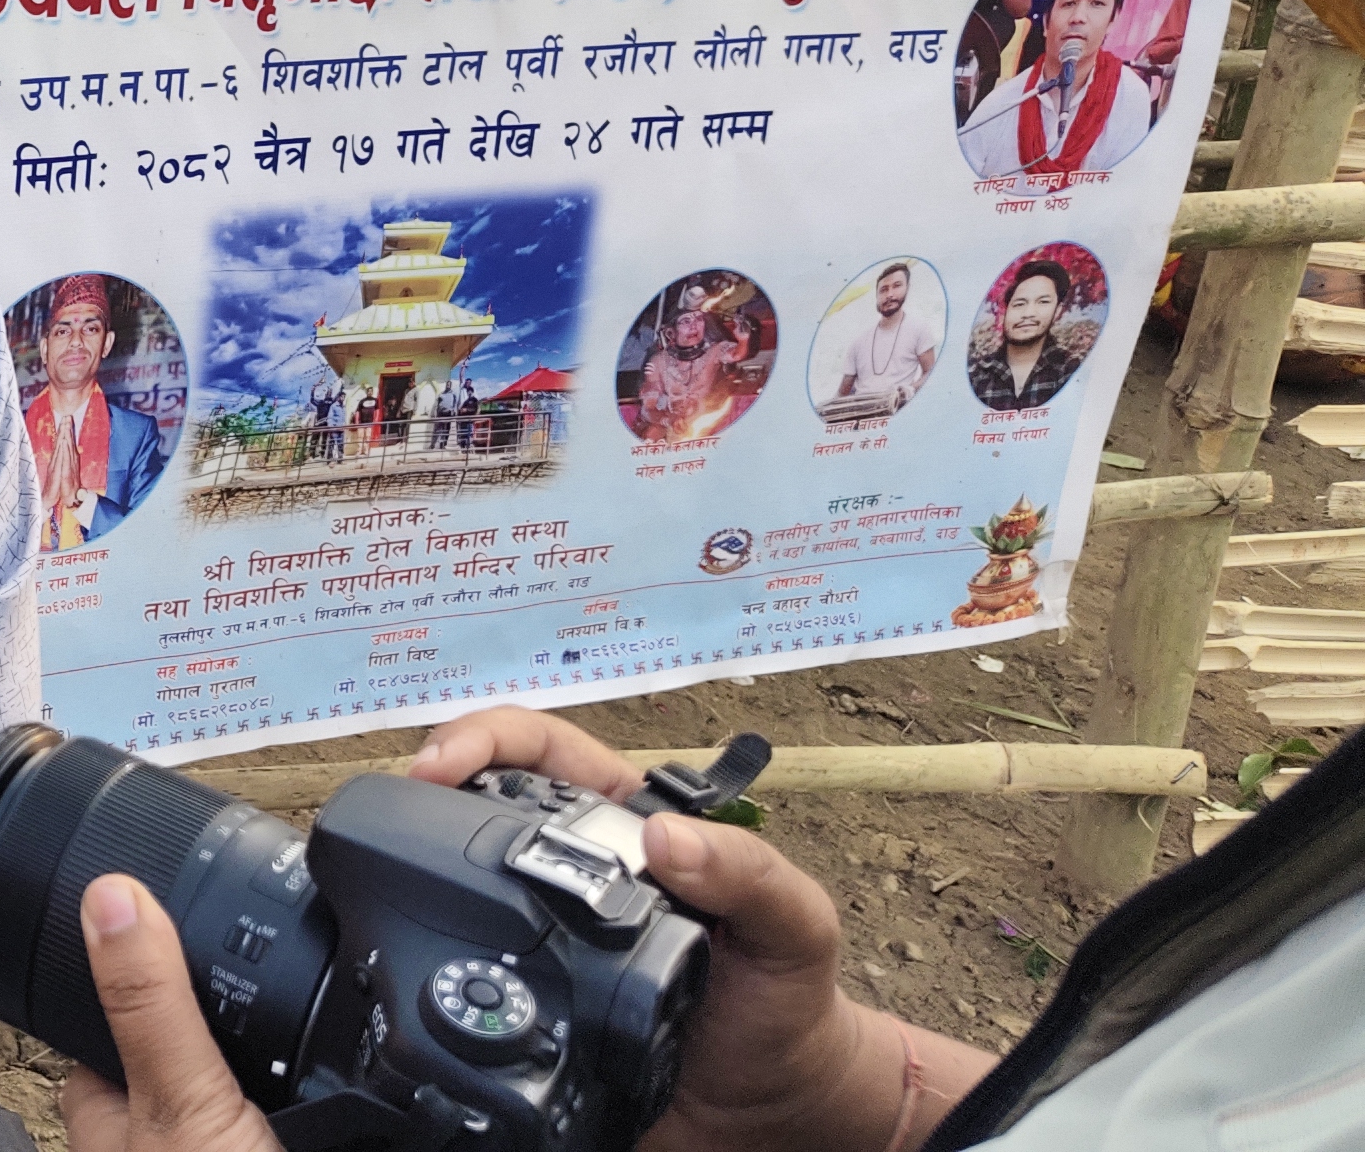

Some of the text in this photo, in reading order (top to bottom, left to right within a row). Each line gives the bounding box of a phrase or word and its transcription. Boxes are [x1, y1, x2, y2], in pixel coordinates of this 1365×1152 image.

[261, 43, 407, 95] शिवशक्ति
[424, 43, 486, 87] टोल
[506, 34, 563, 93] पूर्वी
[582, 28, 676, 81] रजौरा
[694, 24, 767, 72] लौली
[784, 32, 864, 73] गनार,
[889, 29, 948, 65] दाङ
[136, 145, 233, 192] २०८२
[254, 122, 311, 176] चैत्र
[331, 133, 376, 174] १७
[397, 118, 450, 165] गते
[469, 109, 541, 161] देखि
[564, 120, 611, 160] २४
[631, 105, 684, 152] गते
[702, 109, 774, 148] सम्म
[1026, 173, 1064, 189] भजन
[1068, 171, 1113, 186] गायक
[995, 195, 1072, 215] पोषण श्रेष्ठ
[981, 409, 1015, 425] ढोलक
[1012, 425, 1051, 442] परियार
[763, 504, 963, 548] तुलसीपुर उप महानगरपालिका
[203, 520, 569, 582] श्री शिवशक्ति टोल विकास संस्था
[48, 577, 69, 591] राम
[143, 541, 615, 623] तथा शिवशक्ति पशुपतिनाथ मन्दिर परिवार
[741, 601, 767, 615] चन्द्र
[819, 586, 859, 605] चौधरी
[158, 625, 215, 649] तुलसीपुर
[314, 602, 373, 623] शिवशक्ति
[380, 599, 404, 614] टोल
[442, 588, 482, 605] रजौरा
[488, 584, 519, 599] लौली
[371, 627, 429, 645] उपाध्यक्ष
[156, 665, 178, 680] सह
[186, 656, 240, 675] संयोजक
[368, 651, 399, 667] गिता
[157, 676, 257, 702] गोपाल गुरताल
[210, 964, 260, 996] STABILIZER
[211, 979, 254, 1006] ON OFF
[372, 1003, 388, 1043] EOS
[553, 1019, 567, 1037] ON
